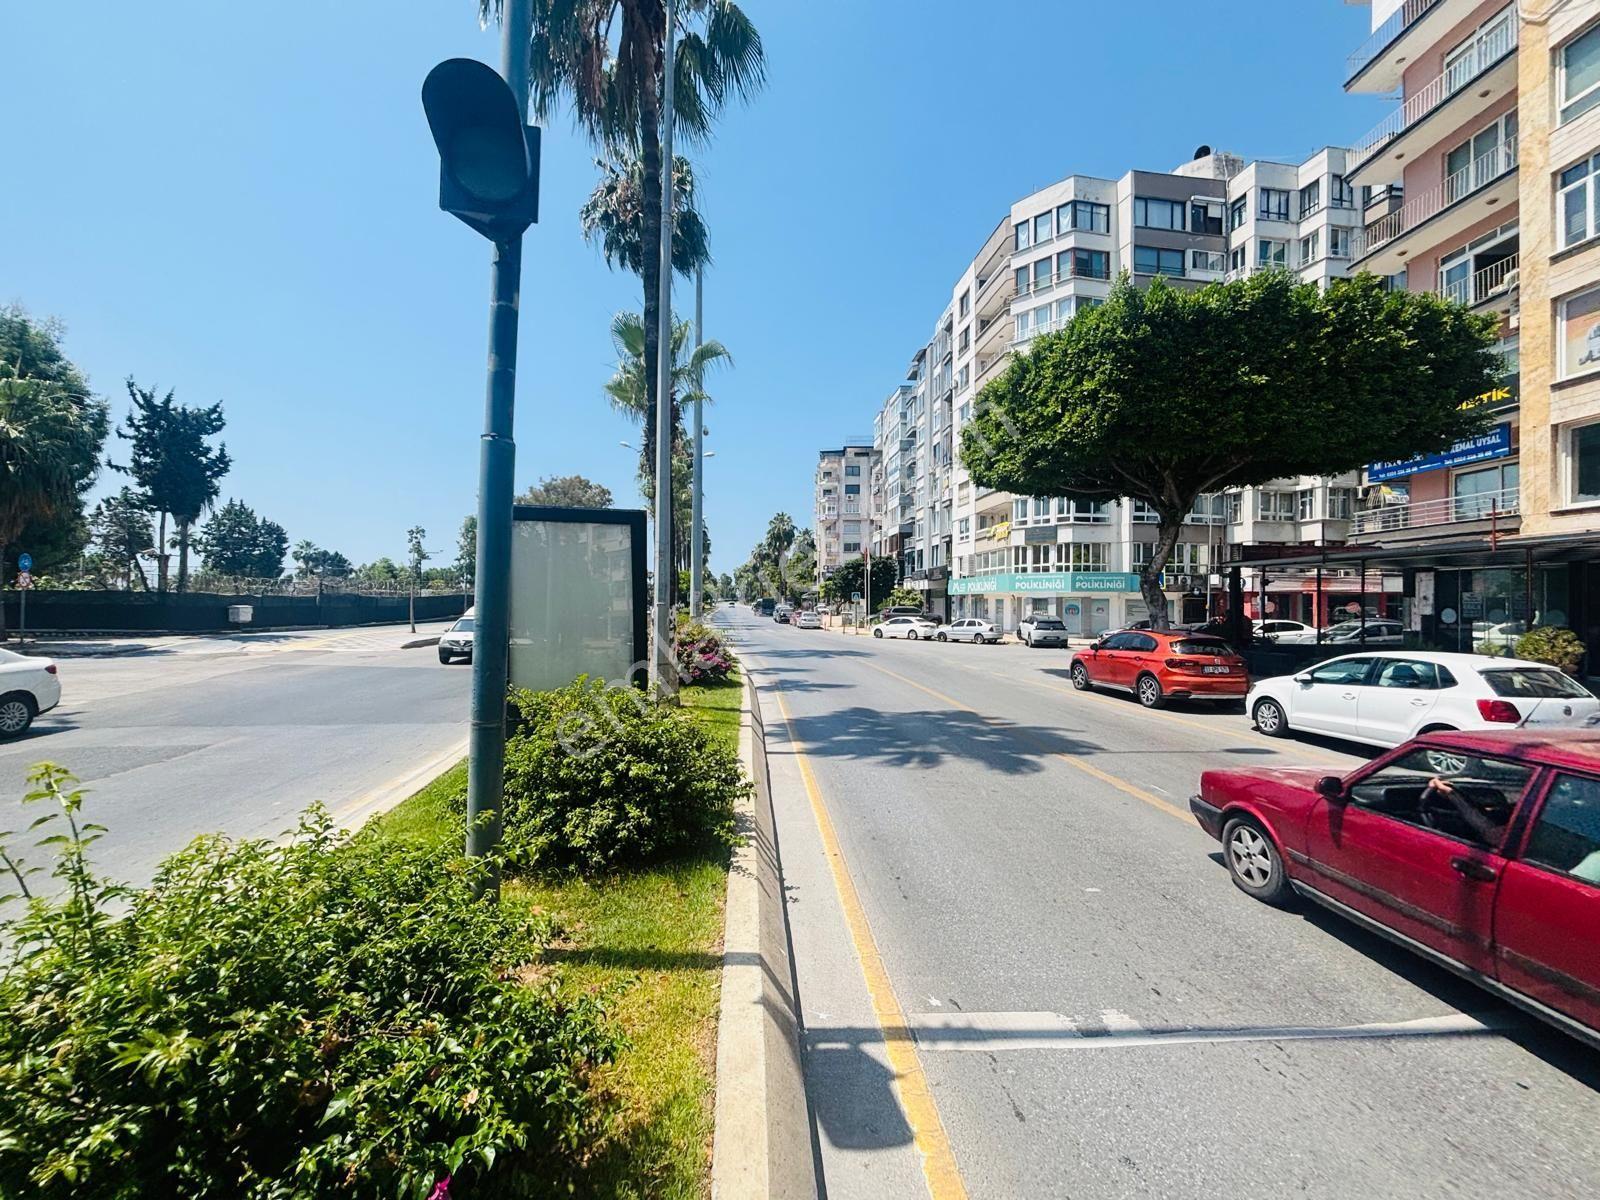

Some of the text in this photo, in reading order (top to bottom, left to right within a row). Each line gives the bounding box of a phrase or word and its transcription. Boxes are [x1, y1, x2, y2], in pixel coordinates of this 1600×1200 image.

[1476, 434, 1502, 447] UYSAL
[1015, 578, 1065, 590] POLİKLİNİĞİ
[1075, 578, 1126, 589] POLİKLİNİĞİ
